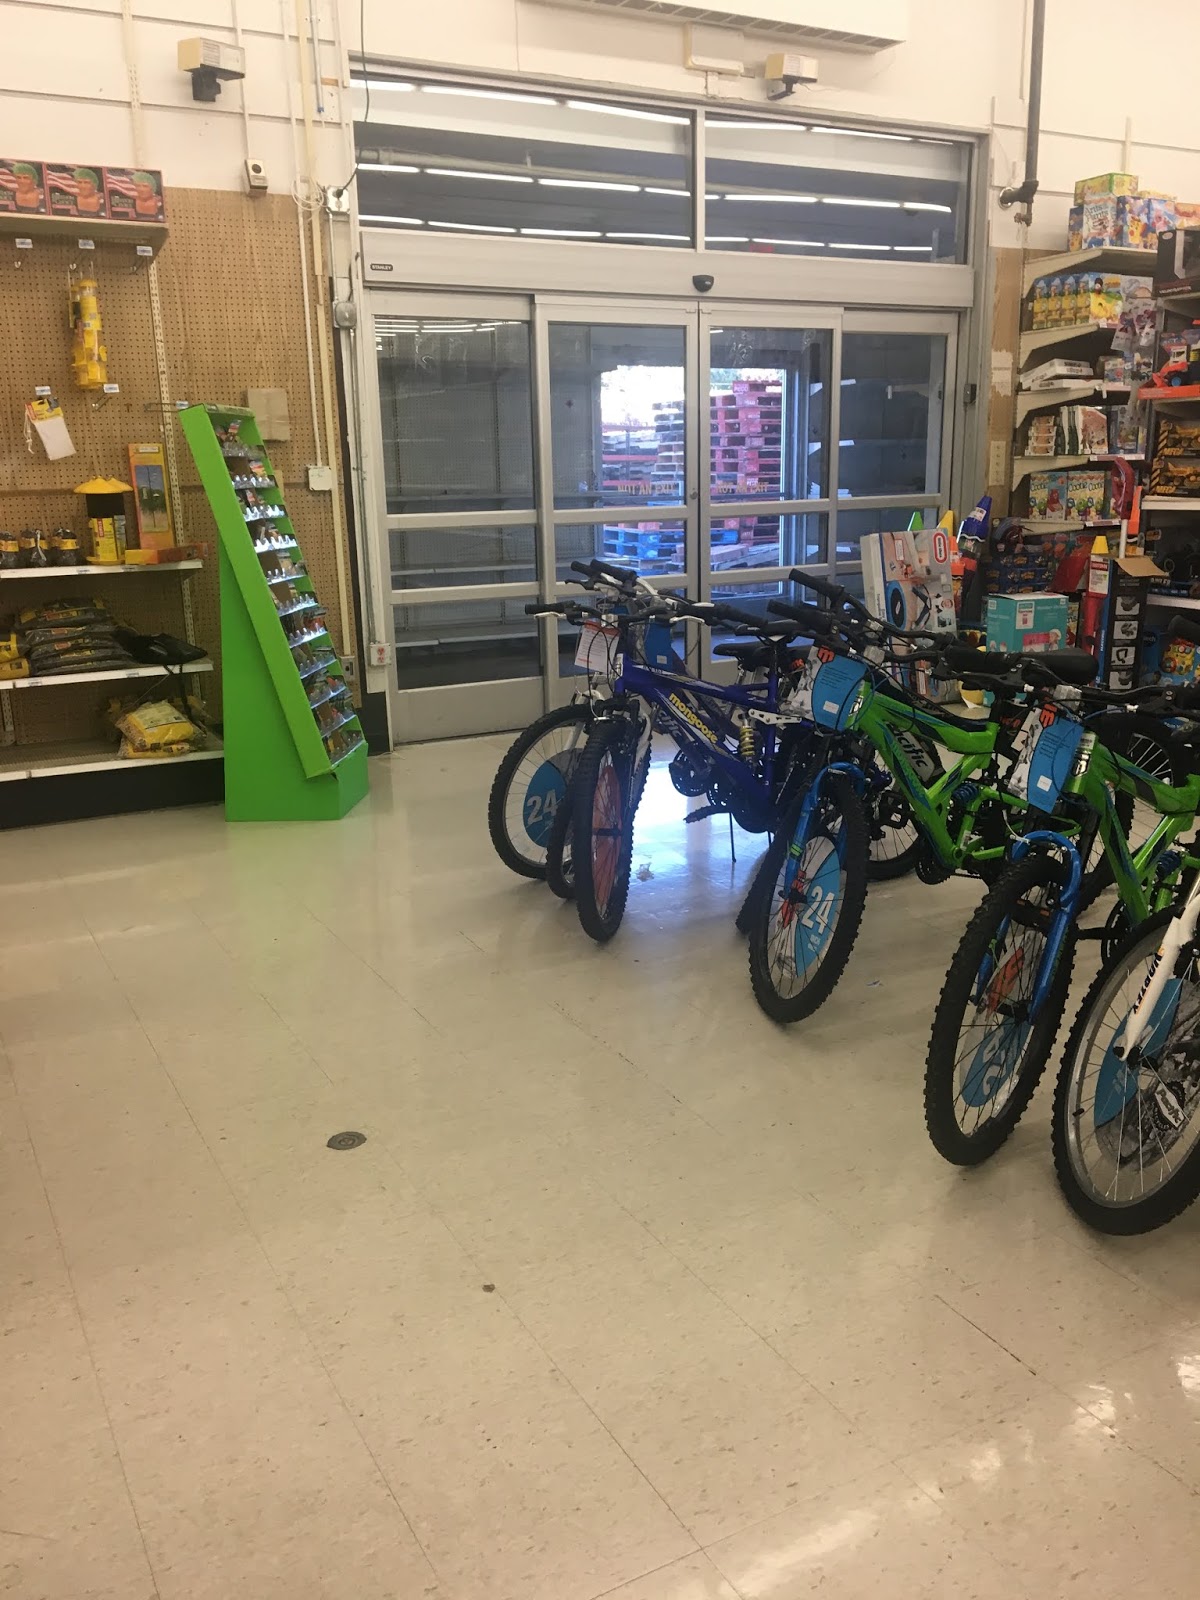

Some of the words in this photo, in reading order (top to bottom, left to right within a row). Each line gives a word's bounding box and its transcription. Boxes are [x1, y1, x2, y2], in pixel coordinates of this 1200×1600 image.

[717, 482, 735, 494] NOT
[751, 481, 770, 494] EXIT
[659, 709, 682, 738] cific
[668, 693, 718, 744] mongoose
[526, 789, 559, 826] 24
[801, 885, 835, 935] 24
[1156, 1088, 1182, 1124] Pacific
